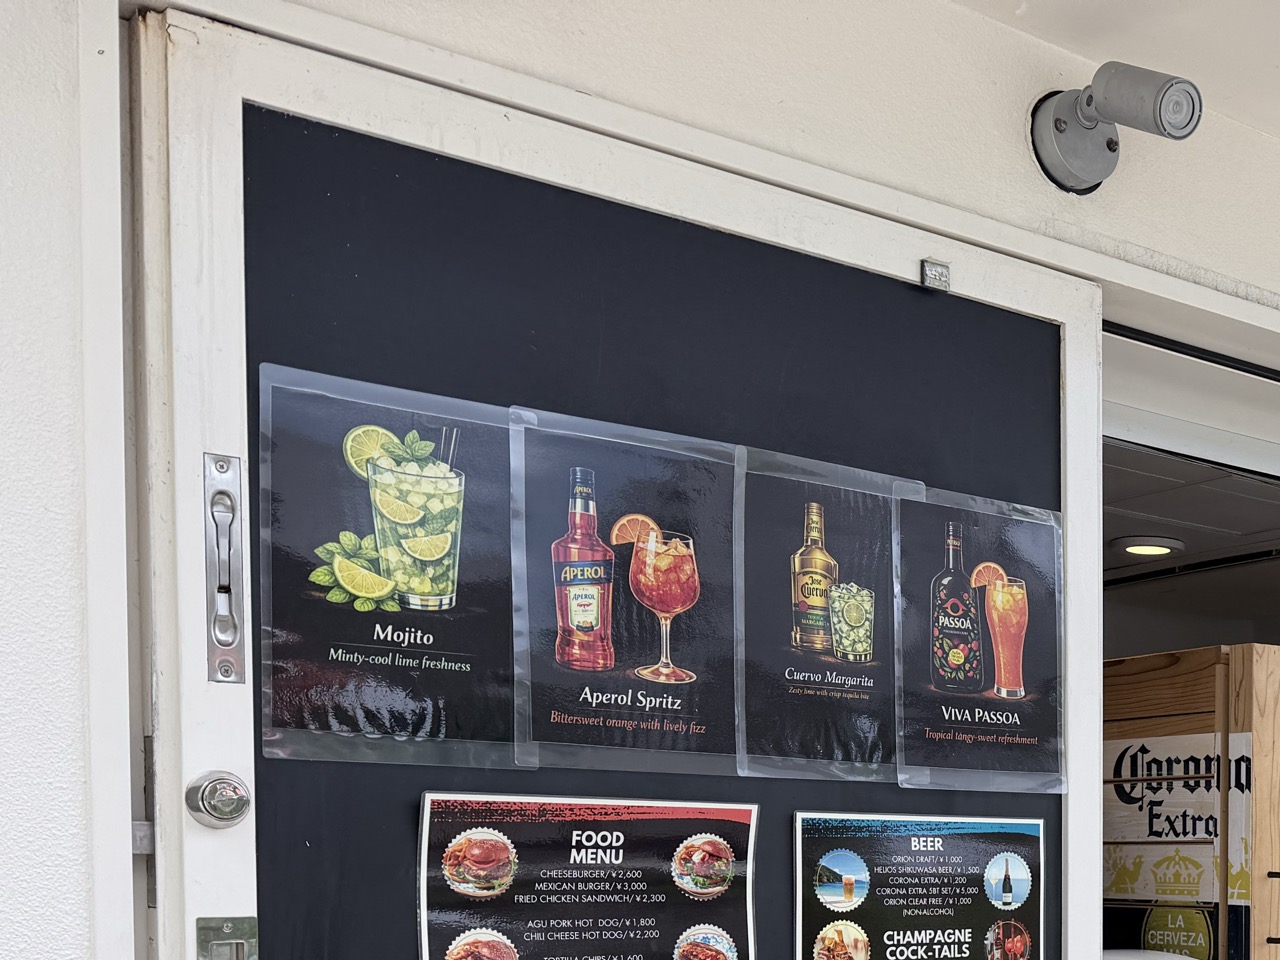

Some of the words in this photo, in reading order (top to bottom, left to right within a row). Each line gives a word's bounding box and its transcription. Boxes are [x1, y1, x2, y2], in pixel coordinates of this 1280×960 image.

[561, 566, 607, 581] APEROL
[809, 576, 822, 586] Jose
[373, 625, 433, 646] Mojito
[328, 649, 392, 665] Minty-cool
[395, 654, 419, 667] lime
[421, 657, 471, 671] freshness
[784, 668, 822, 682] Cuervo
[824, 672, 874, 687] Margarita
[579, 688, 632, 707] Aperol
[636, 693, 681, 711] Spritz
[550, 712, 603, 726] Bittersweet
[605, 715, 638, 728] orange
[639, 717, 660, 730] with
[663, 719, 688, 731] lively
[689, 720, 706, 732] fizz
[941, 706, 971, 721] VIVA
[974, 709, 1020, 725] PASSOA
[924, 728, 953, 740] Tropical
[955, 730, 996, 742] tangy-sweet
[998, 733, 1038, 745] refreshment
[1113, 744, 1252, 811] Corona
[1146, 800, 1219, 838] Extra
[571, 831, 624, 847] FOOD
[911, 838, 944, 850] BEER
[569, 849, 623, 865] MENU
[534, 882, 575, 891] MEXICAN
[875, 887, 907, 895] CORONA
[908, 887, 927, 895] EXTRA
[514, 895, 538, 904] FRIED
[539, 894, 579, 904] CHICKEN
[902, 908, 954, 916] (NON-ALCOHOL)
[526, 919, 547, 928] AGU
[549, 919, 573, 928] PORK
[574, 918, 593, 928] HOT
[1168, 914, 1184, 928] LA
[523, 931, 545, 941] CHILI
[546, 931, 579, 940] CHEESE
[581, 930, 600, 940] HOT
[883, 929, 972, 944] CHAMPAGNE
[1148, 931, 1205, 946] CERVEZA
[885, 945, 970, 960] COCK-TAILS
